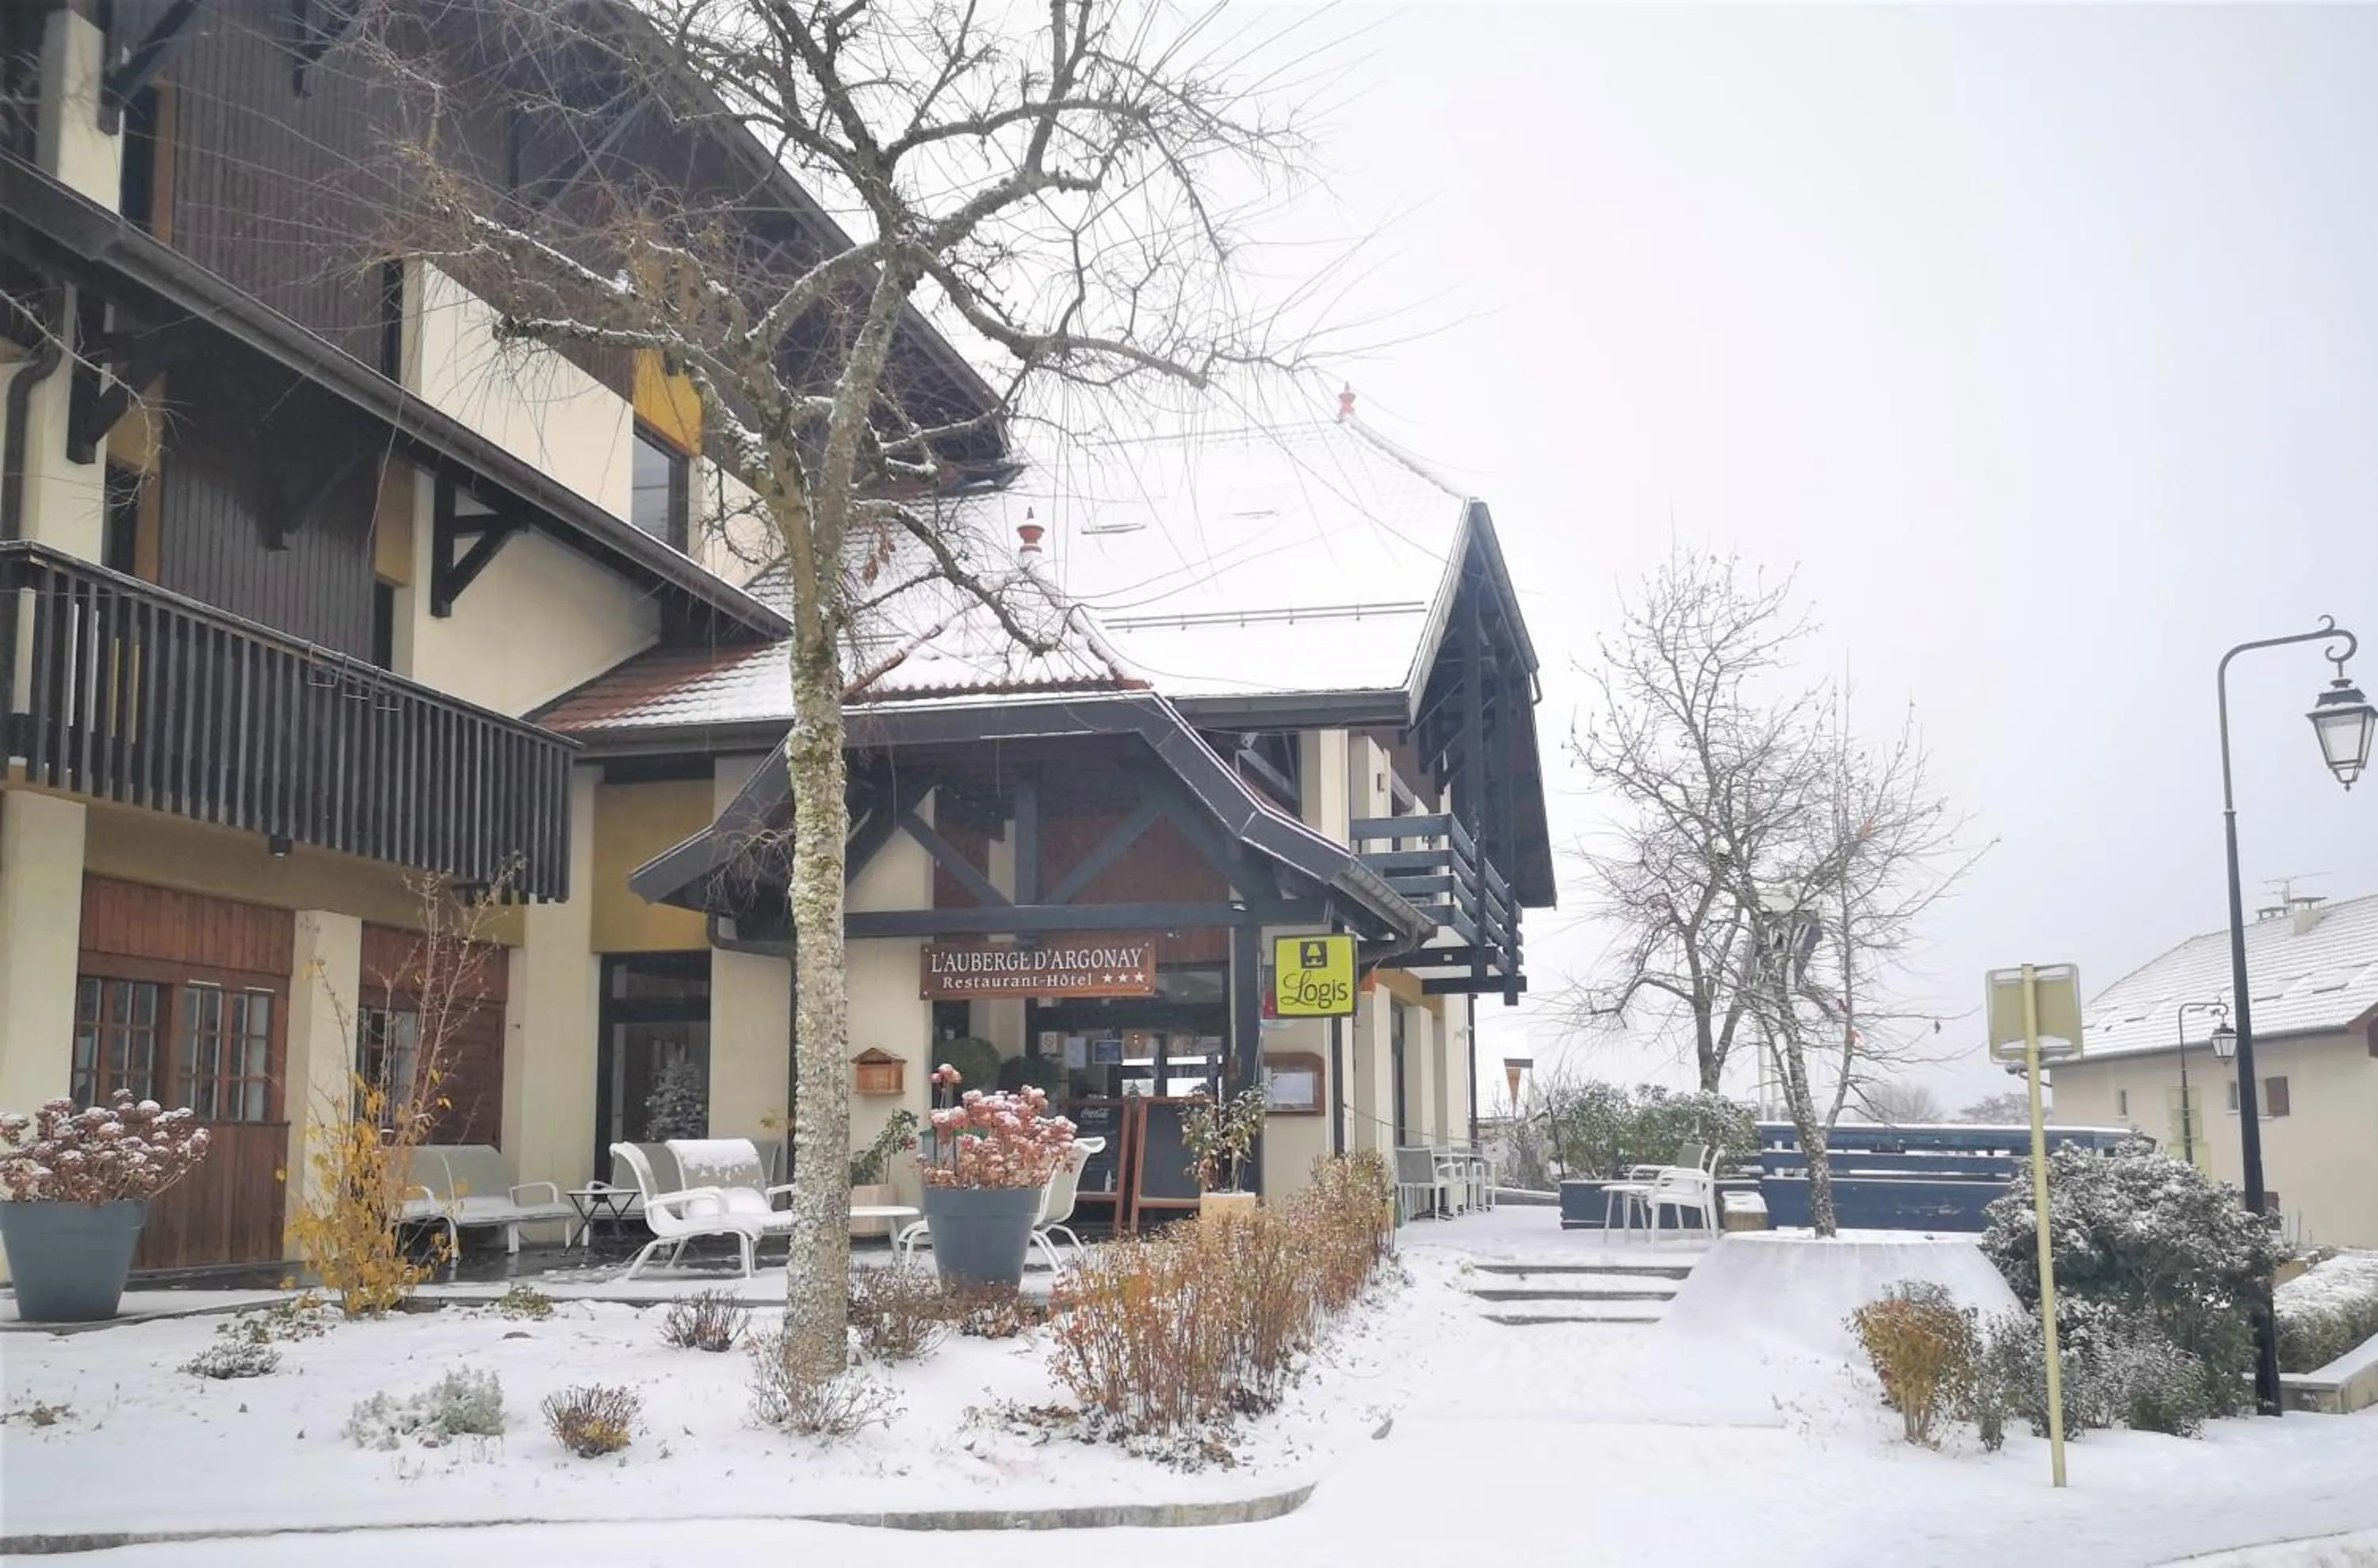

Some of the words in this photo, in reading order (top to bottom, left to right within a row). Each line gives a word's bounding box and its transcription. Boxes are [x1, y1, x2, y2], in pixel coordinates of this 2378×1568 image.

[931, 951, 1030, 973] L'AUBERGE
[1034, 948, 1142, 969] D'ARGONAY
[1280, 969, 1348, 1009] Logis
